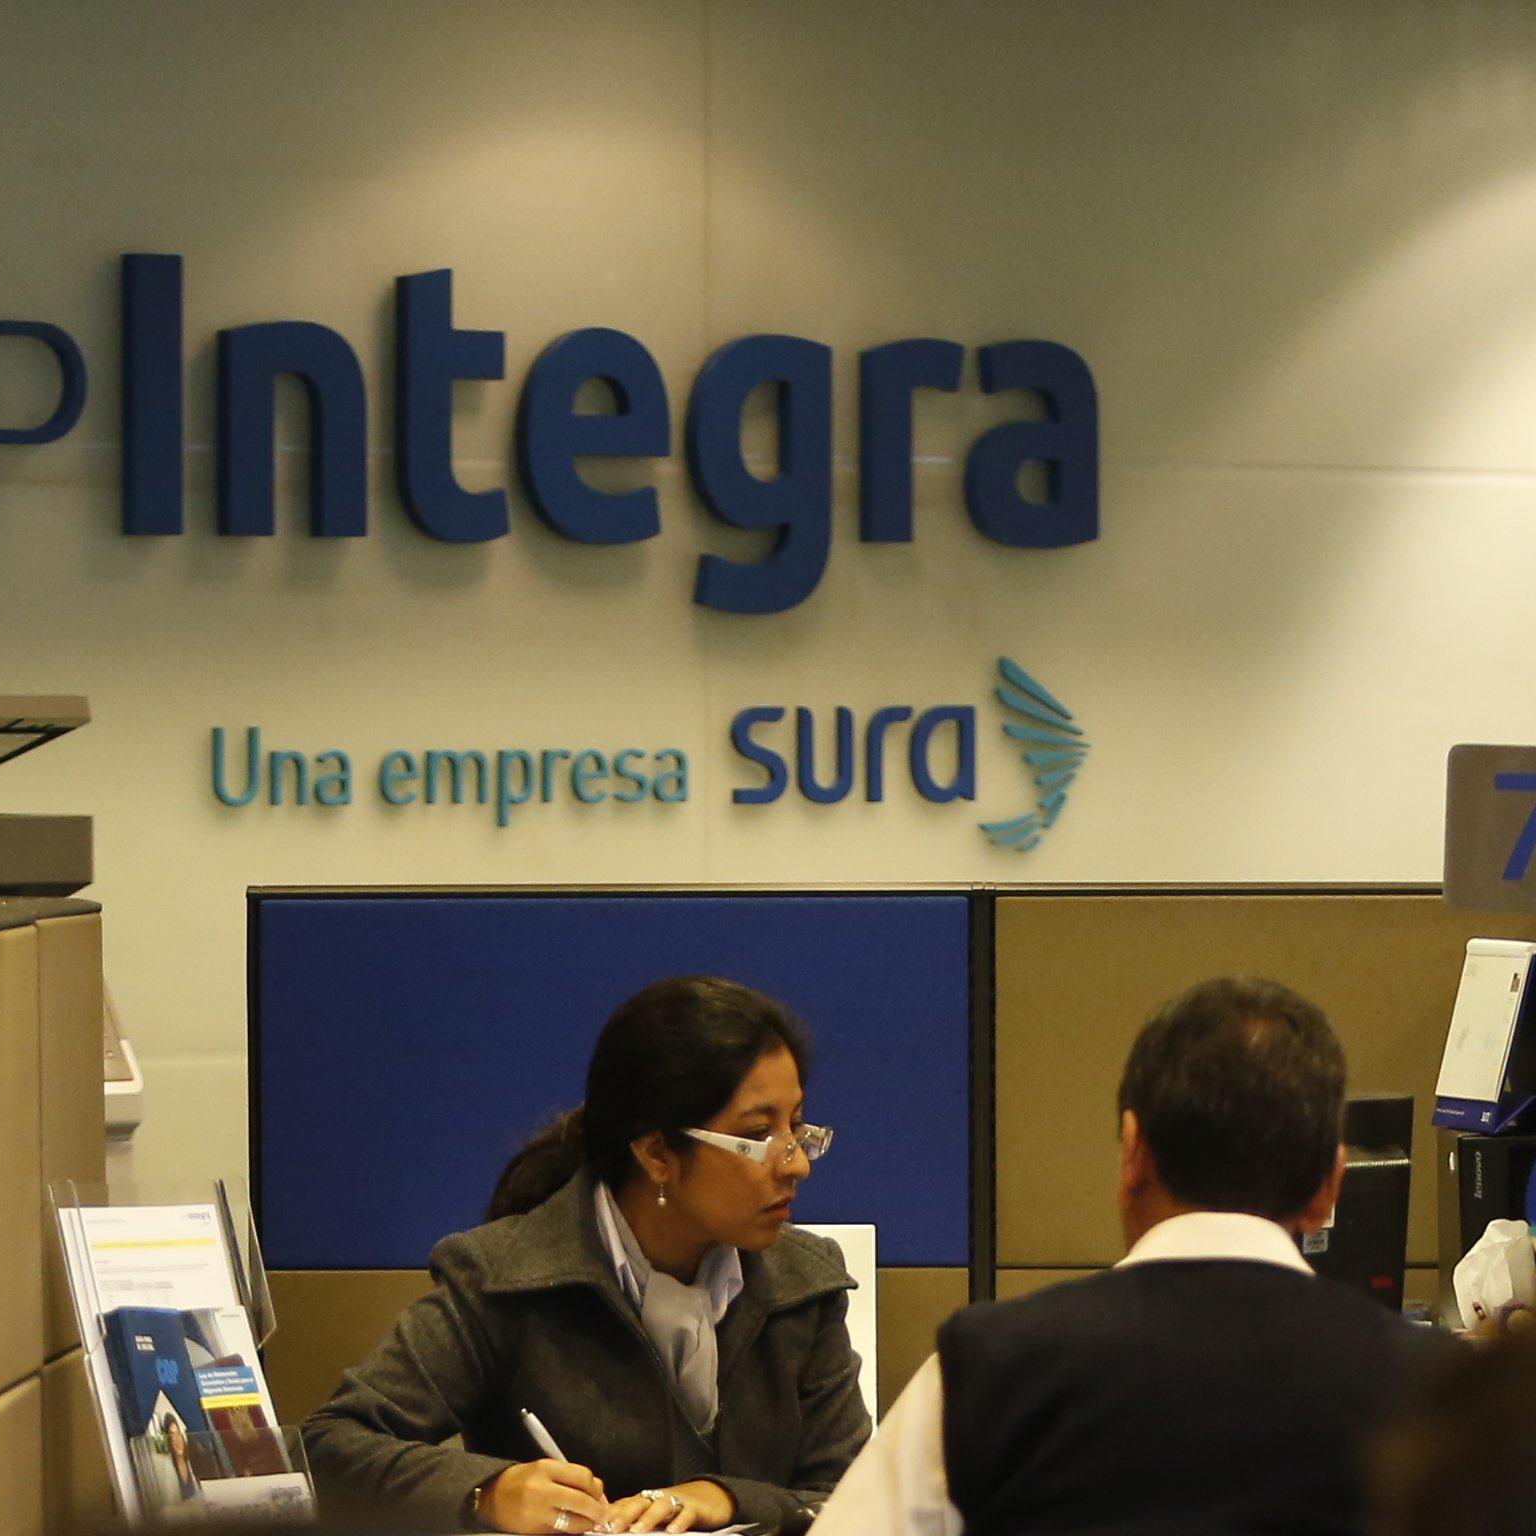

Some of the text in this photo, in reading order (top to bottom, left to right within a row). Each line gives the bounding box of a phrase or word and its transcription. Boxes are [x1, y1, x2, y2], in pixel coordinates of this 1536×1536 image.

[119, 253, 1100, 615] Integra
[211, 705, 977, 828] Una empresa sura
